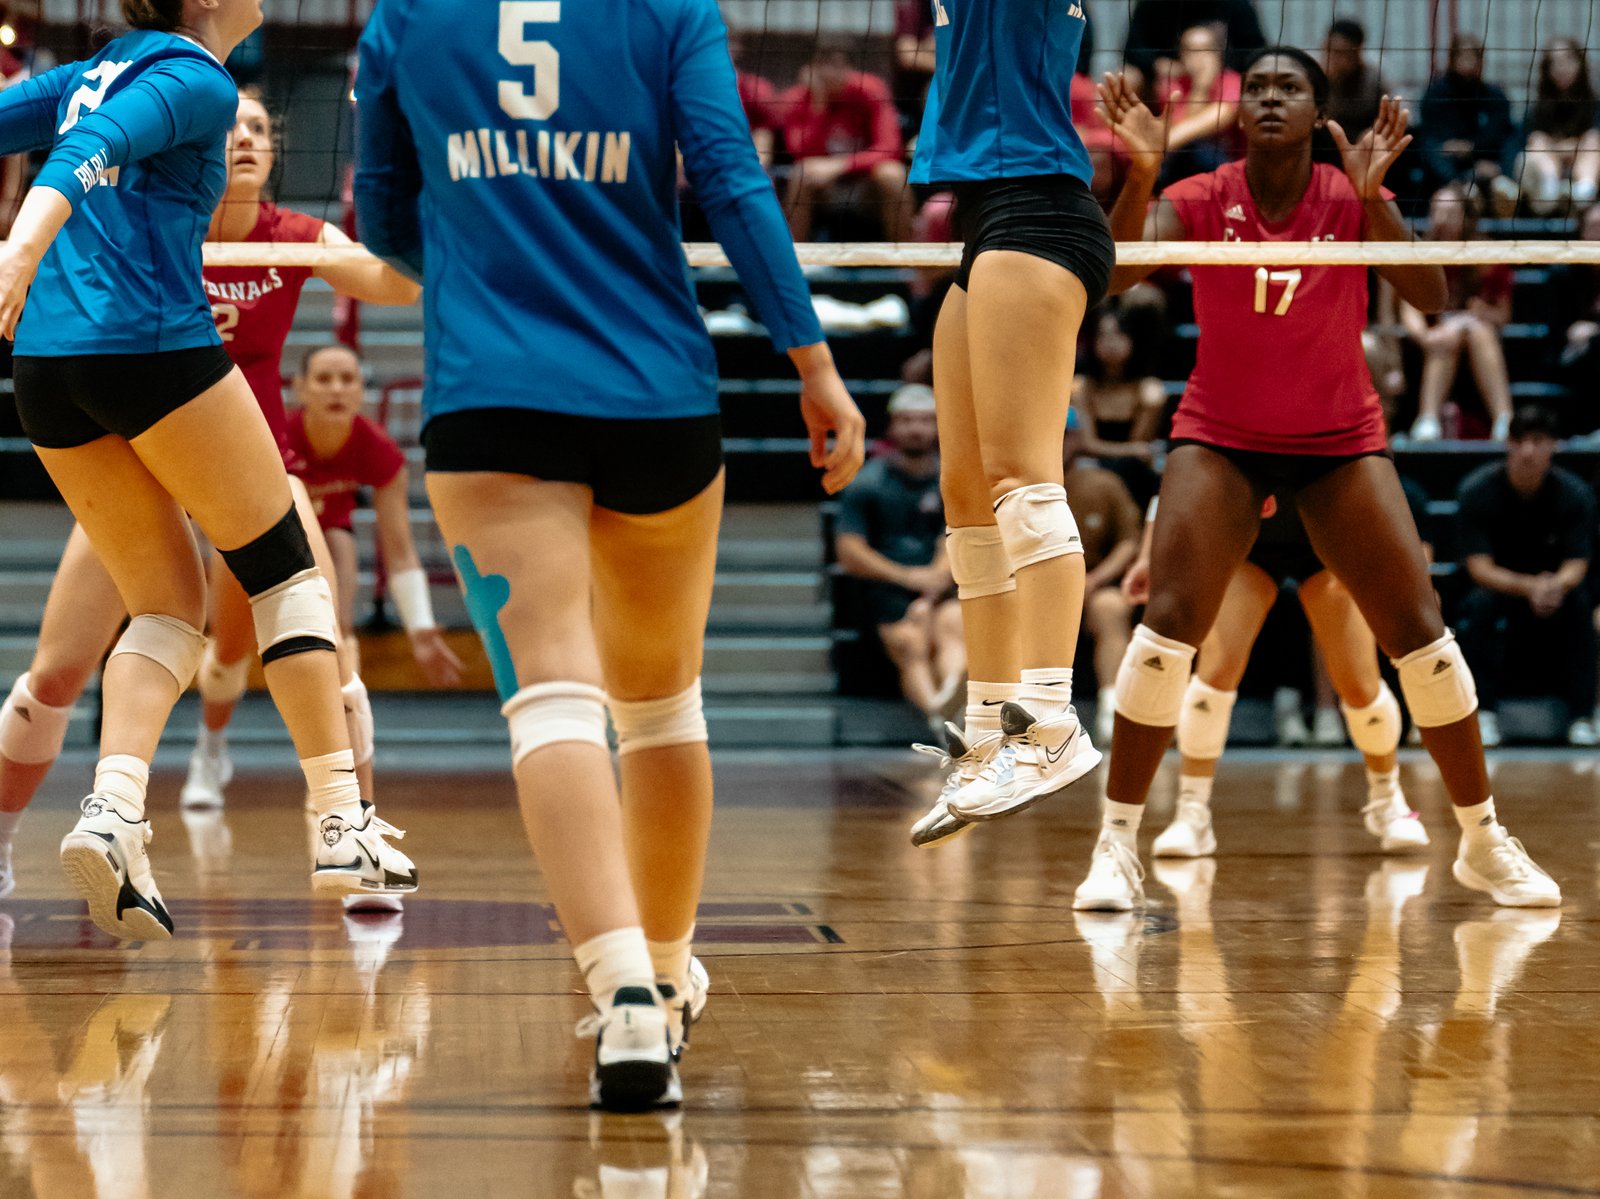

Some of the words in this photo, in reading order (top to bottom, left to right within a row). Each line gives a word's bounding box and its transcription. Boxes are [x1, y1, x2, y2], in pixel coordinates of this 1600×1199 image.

[497, 0, 562, 121] 5
[447, 127, 632, 184] MILLIKIN
[202, 267, 284, 301] DINALS
[1253, 266, 1302, 317] 17
